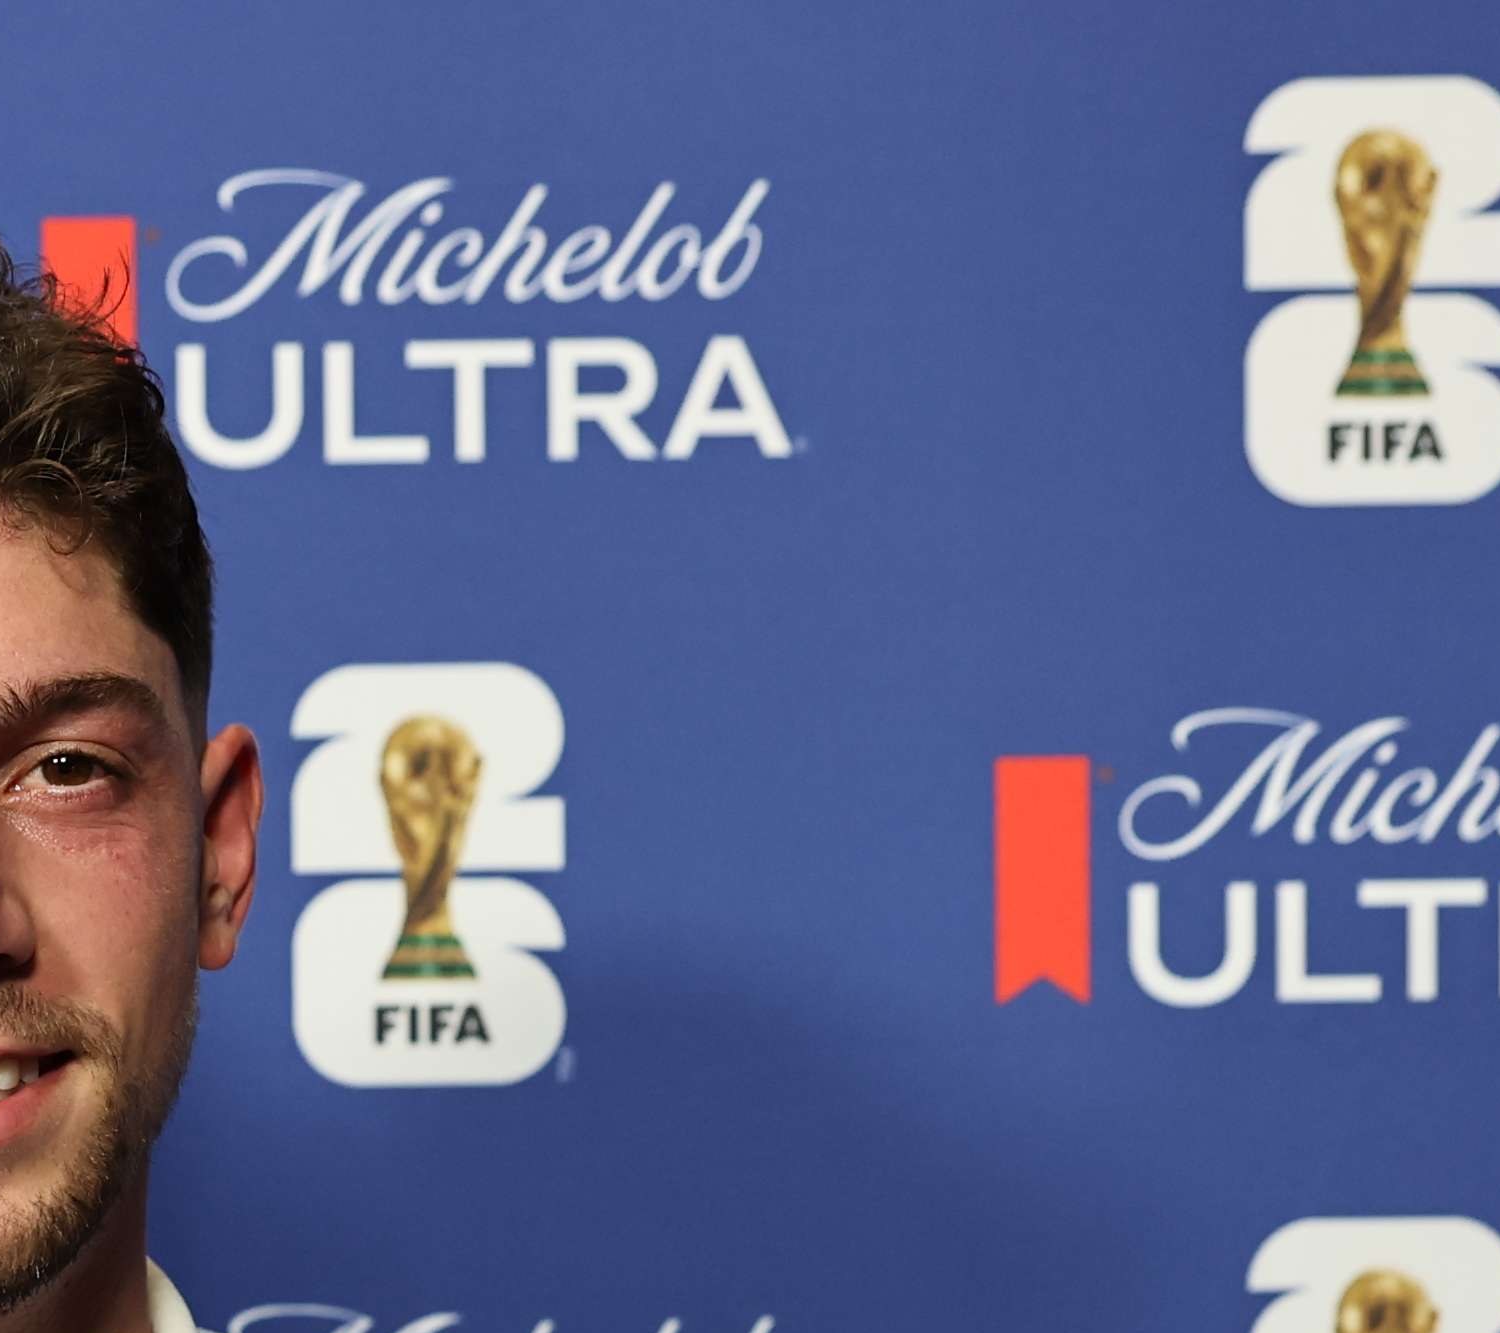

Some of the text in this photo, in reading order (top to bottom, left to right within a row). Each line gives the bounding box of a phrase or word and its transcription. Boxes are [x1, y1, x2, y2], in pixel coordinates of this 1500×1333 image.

[166, 170, 768, 321] Michelob
[176, 338, 792, 469] ULTRA
[1328, 422, 1443, 462] FIFA
[375, 1004, 490, 1045] FIFA
